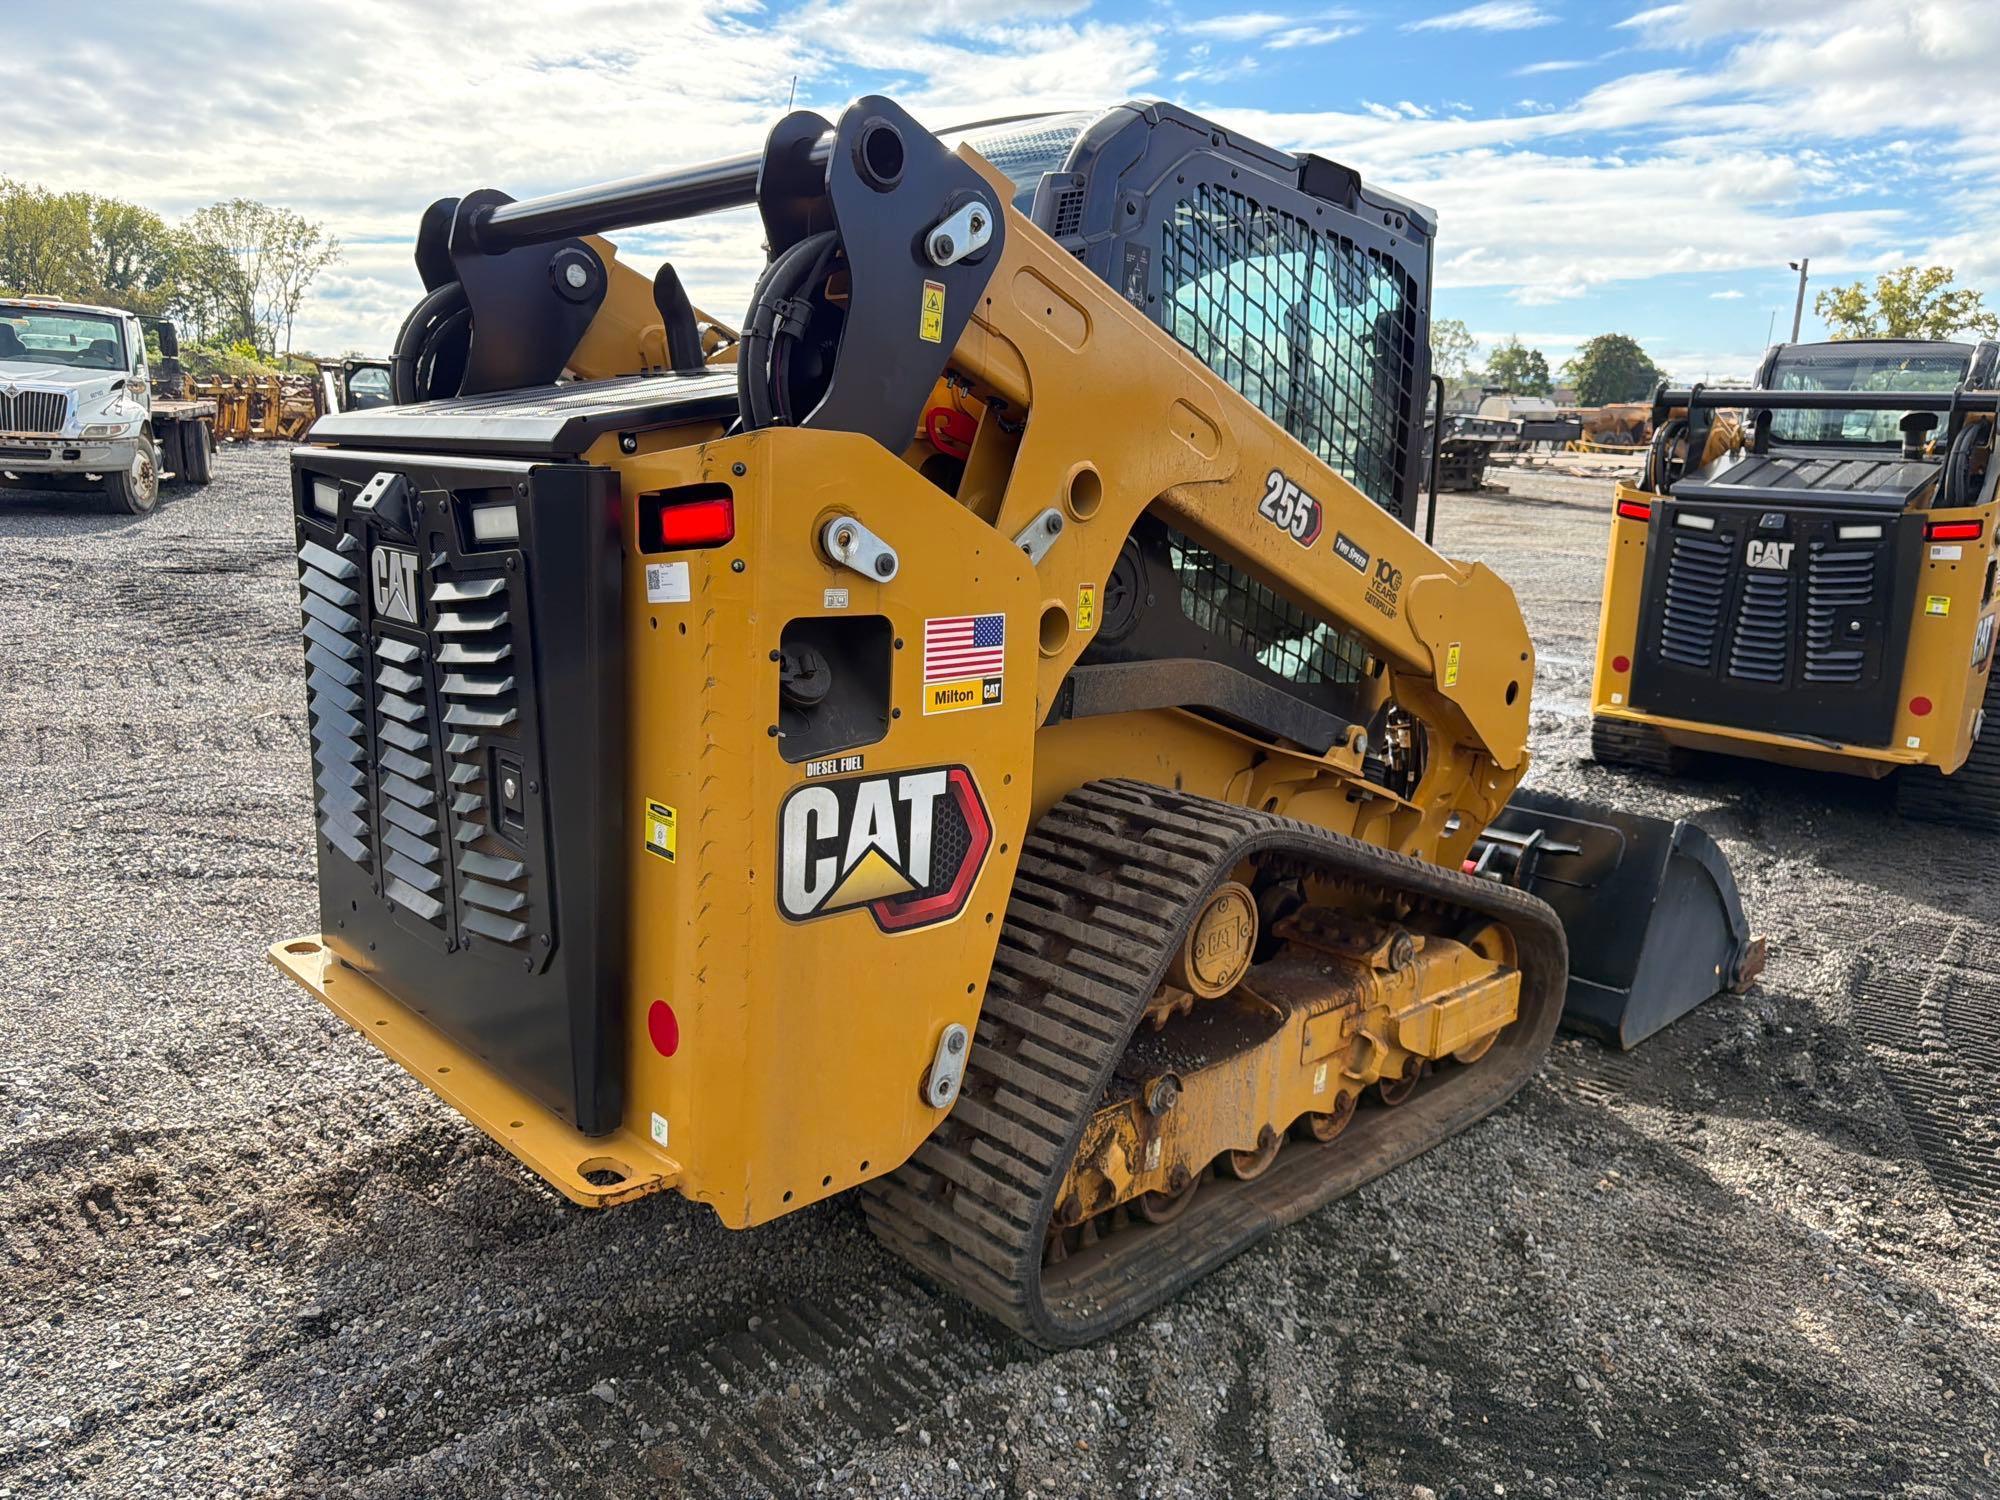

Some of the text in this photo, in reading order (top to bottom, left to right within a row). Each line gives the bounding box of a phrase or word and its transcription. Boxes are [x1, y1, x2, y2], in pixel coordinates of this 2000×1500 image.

[1261, 471, 1313, 538] 255
[1746, 540, 1795, 570] CAT
[371, 546, 419, 623] CAT
[1371, 578, 1398, 604] YEARS
[1972, 614, 1995, 667] CAT
[935, 690, 974, 705] Milton
[984, 683, 1000, 699] CAT
[806, 756, 862, 777] DIESEL FUEL
[782, 770, 948, 915] CAT
[1208, 926, 1235, 956] CAT
